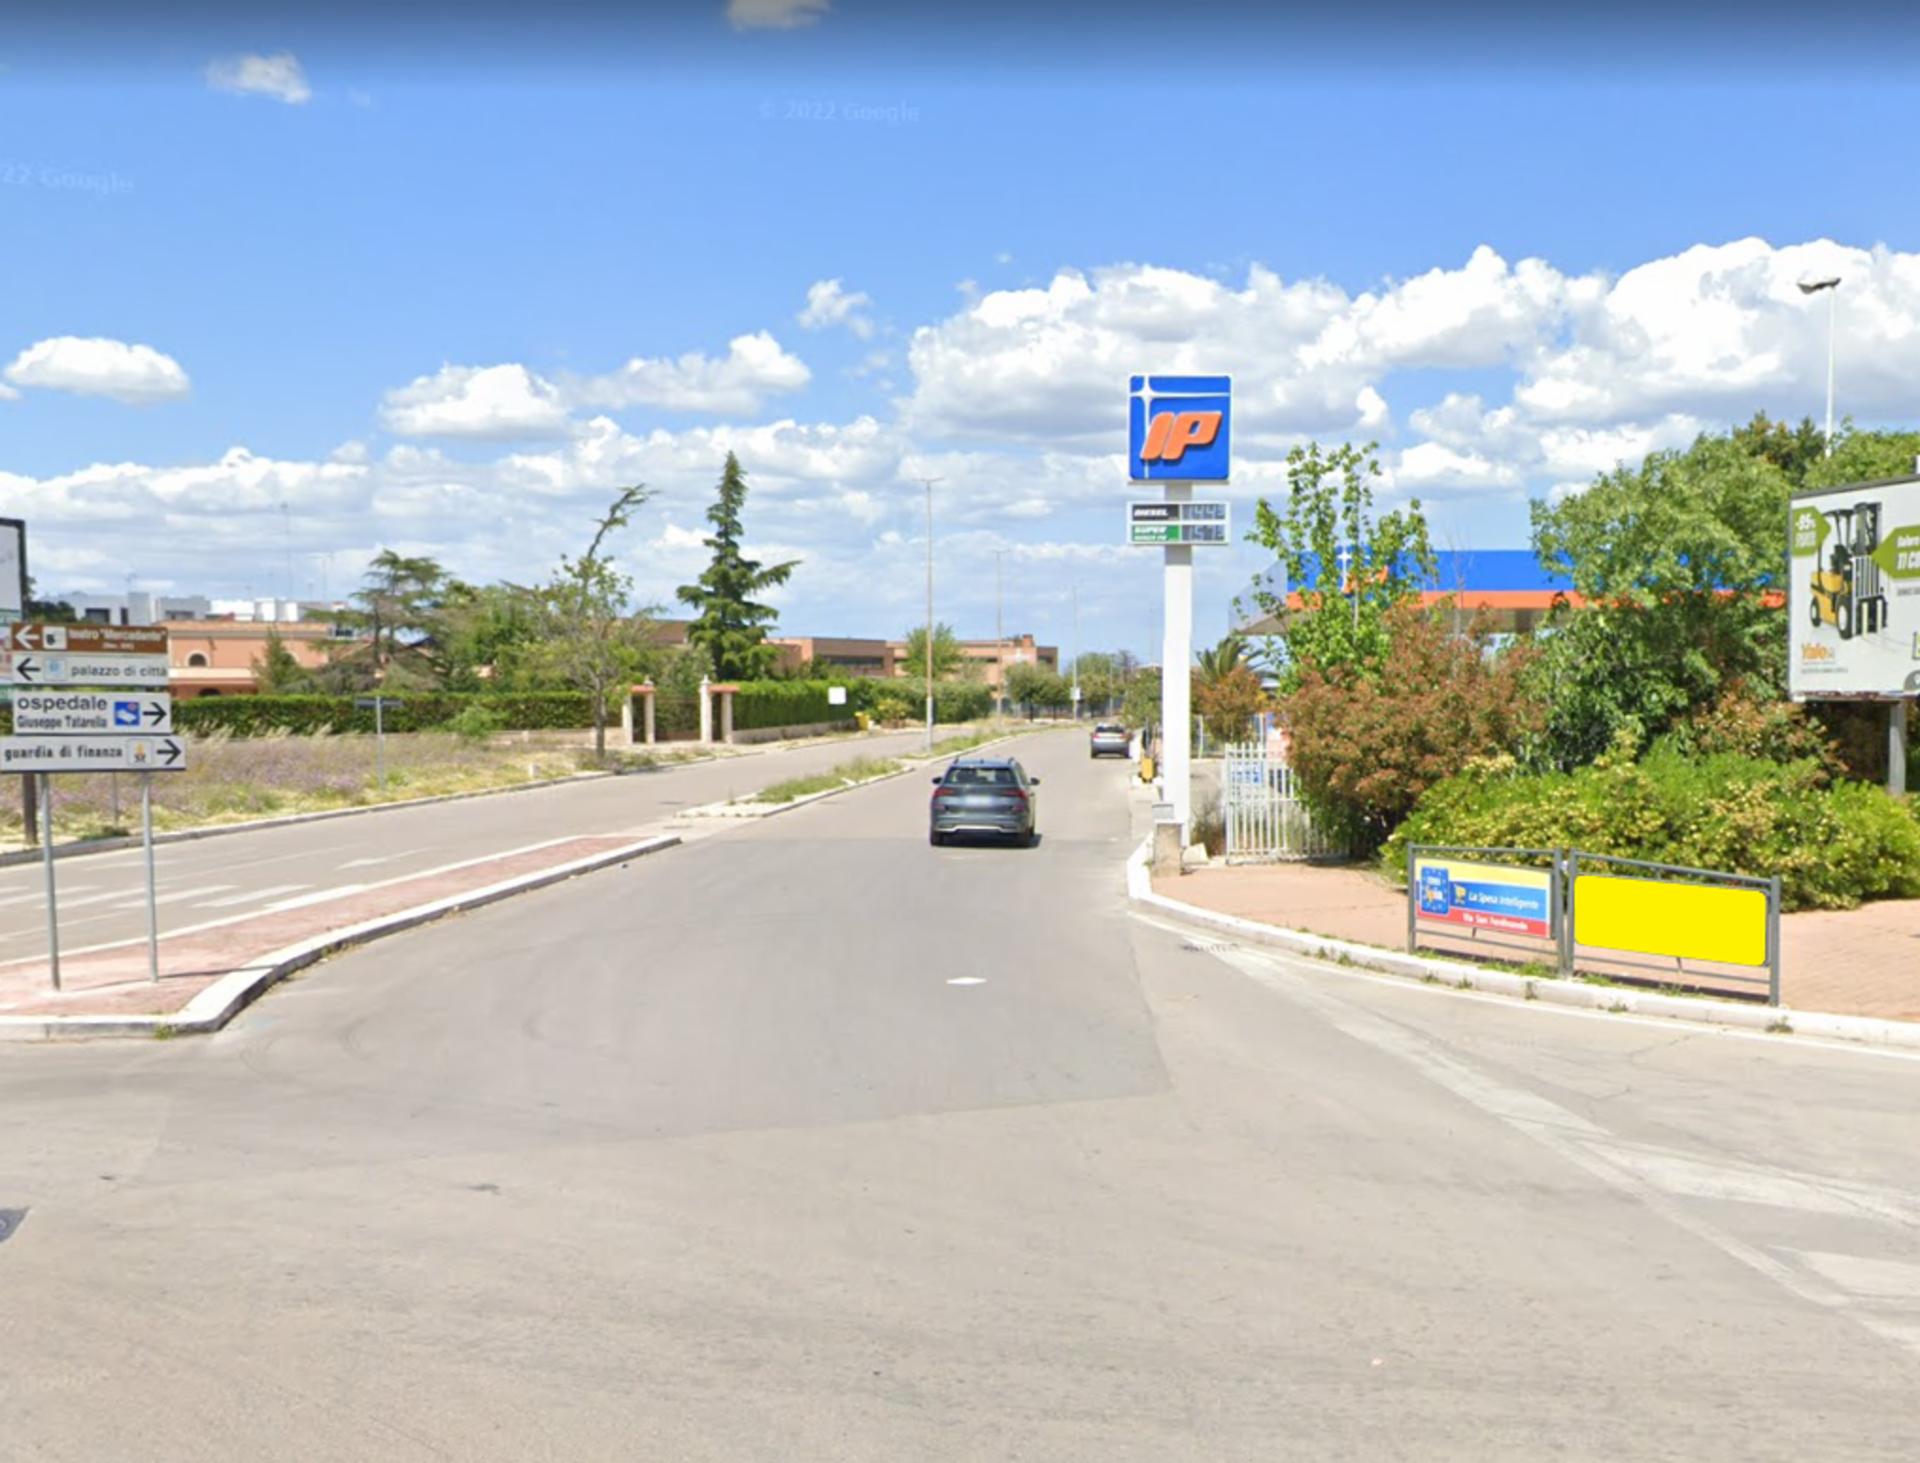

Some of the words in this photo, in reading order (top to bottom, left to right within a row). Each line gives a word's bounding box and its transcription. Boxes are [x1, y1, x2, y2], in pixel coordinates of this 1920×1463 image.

[1140, 411, 1223, 461] IP
[71, 664, 120, 676] palazzo
[124, 664, 137, 676] di
[17, 695, 108, 713] ospedale
[17, 715, 62, 729] Giuseppe
[65, 715, 108, 728] Tatarella
[5, 746, 53, 761] guardia
[60, 745, 72, 758] di
[77, 745, 122, 758] finanza
